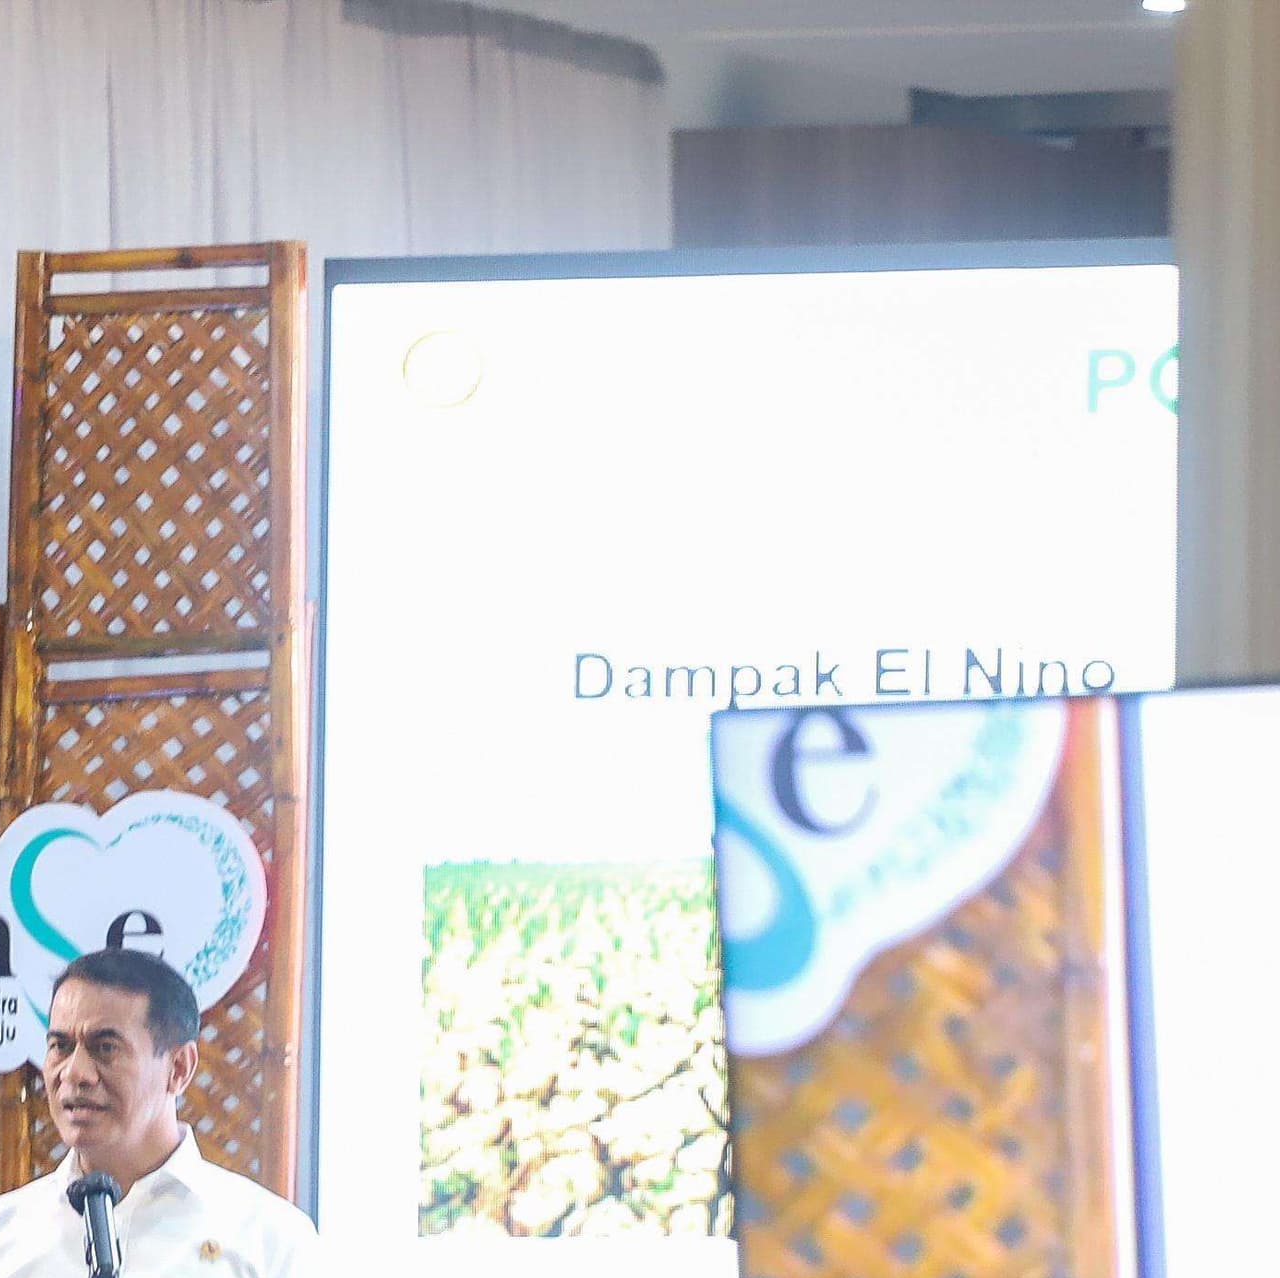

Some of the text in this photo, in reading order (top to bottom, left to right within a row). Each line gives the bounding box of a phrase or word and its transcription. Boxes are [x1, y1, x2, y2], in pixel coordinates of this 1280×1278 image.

[574, 647, 1116, 709] Dampak El Nino
